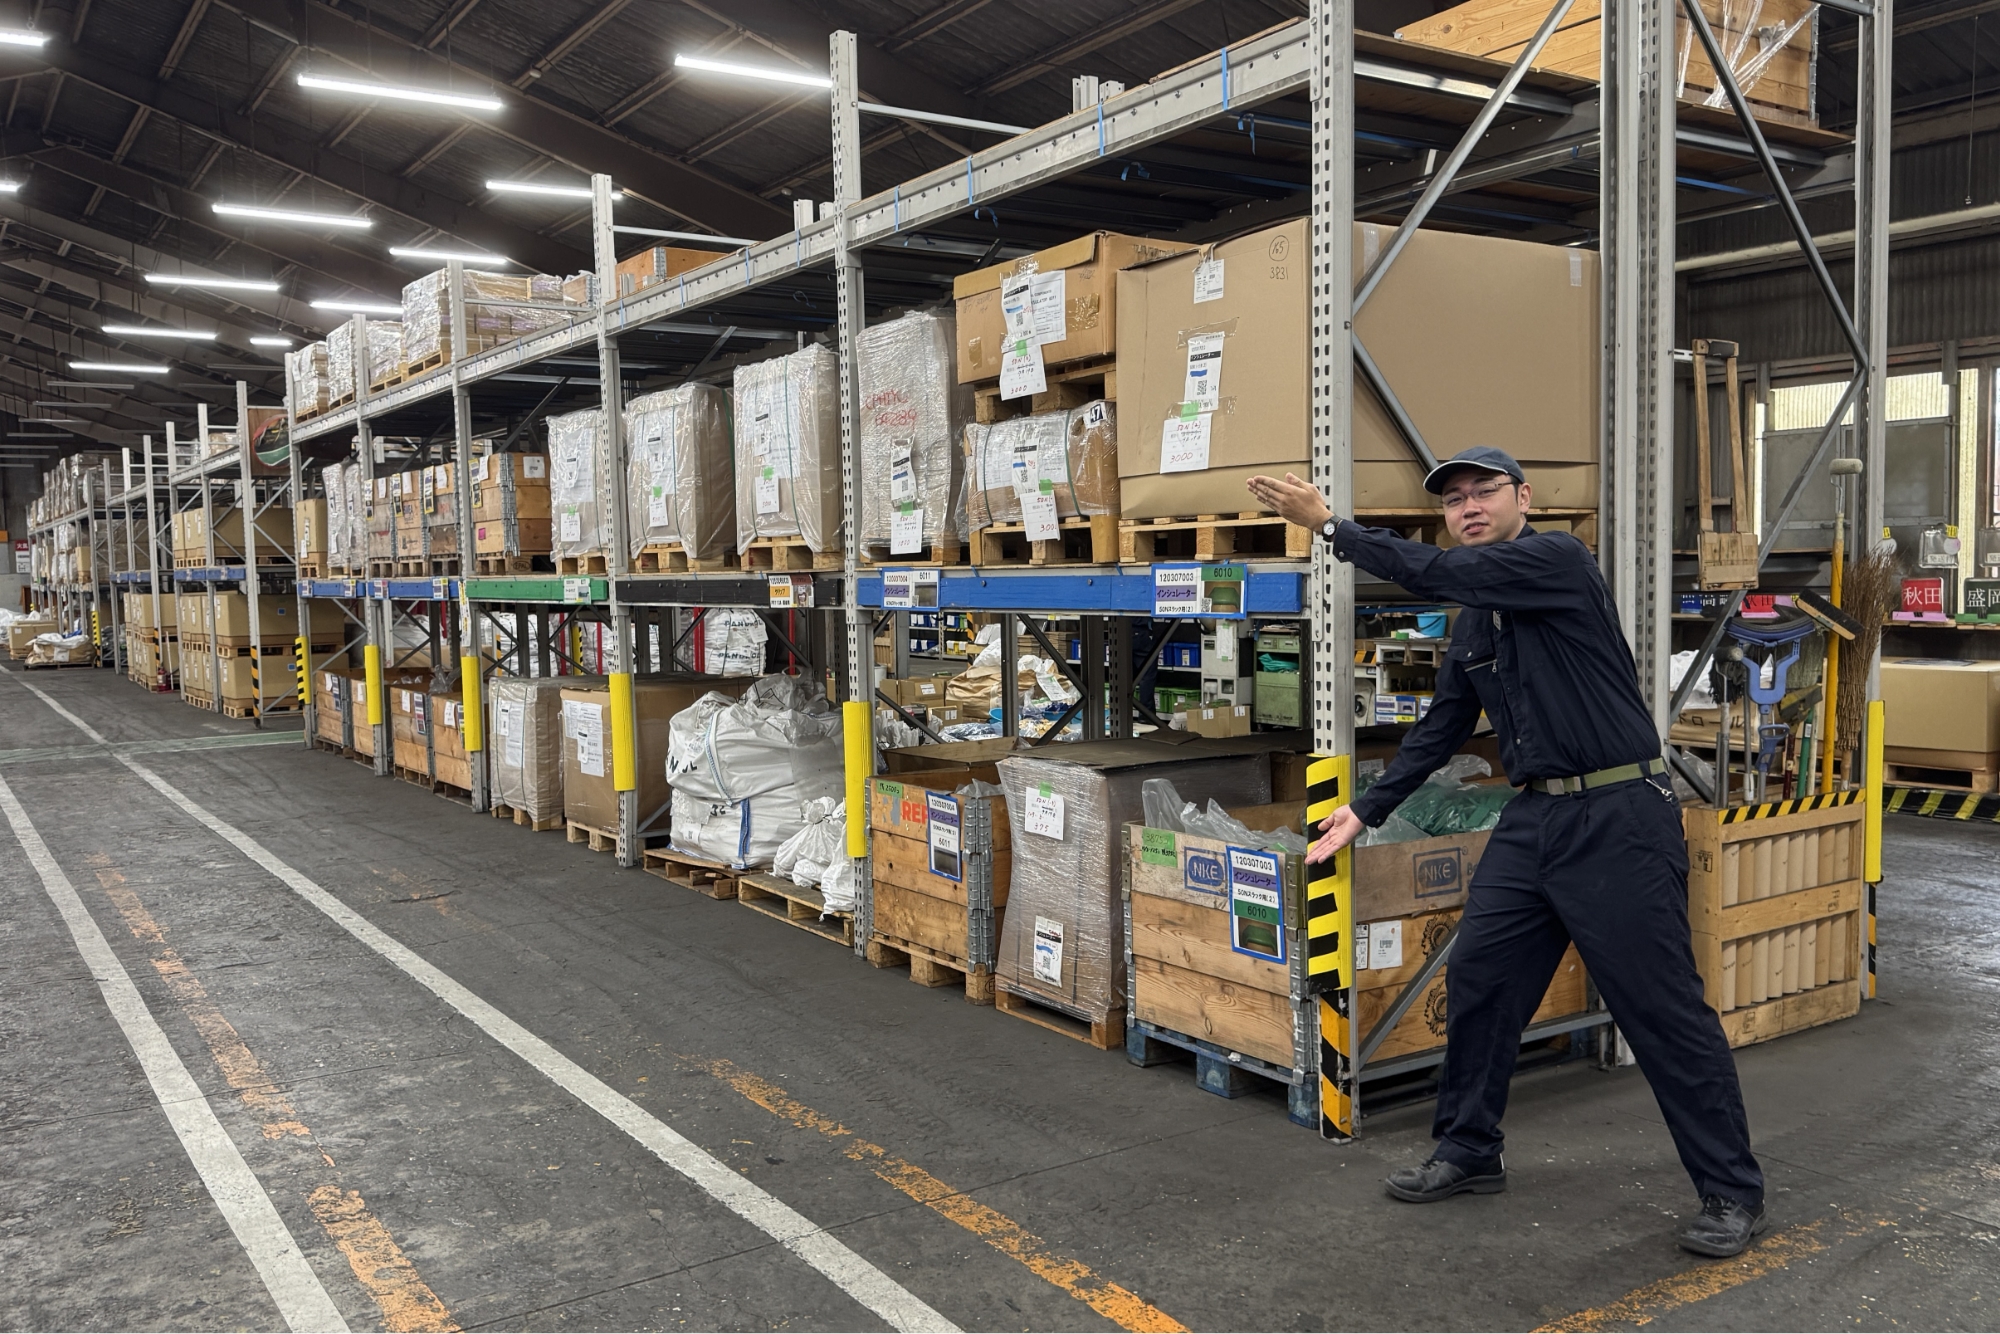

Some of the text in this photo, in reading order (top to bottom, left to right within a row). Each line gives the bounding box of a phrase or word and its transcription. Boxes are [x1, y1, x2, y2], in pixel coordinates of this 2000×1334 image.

[1169, 452, 1194, 464] 3000
[1159, 572, 1194, 582] 120307003
[1213, 567, 1233, 578] 6010
[1157, 589, 1196, 598] インシュレーター
[1903, 586, 1942, 605] 秋田
[938, 837, 951, 848] 6011
[1235, 855, 1273, 871] 120307003
[1191, 861, 1218, 880] NKE
[1424, 862, 1451, 882] NKE
[1234, 871, 1277, 887] インシュレーター
[1247, 905, 1267, 919] 6010
